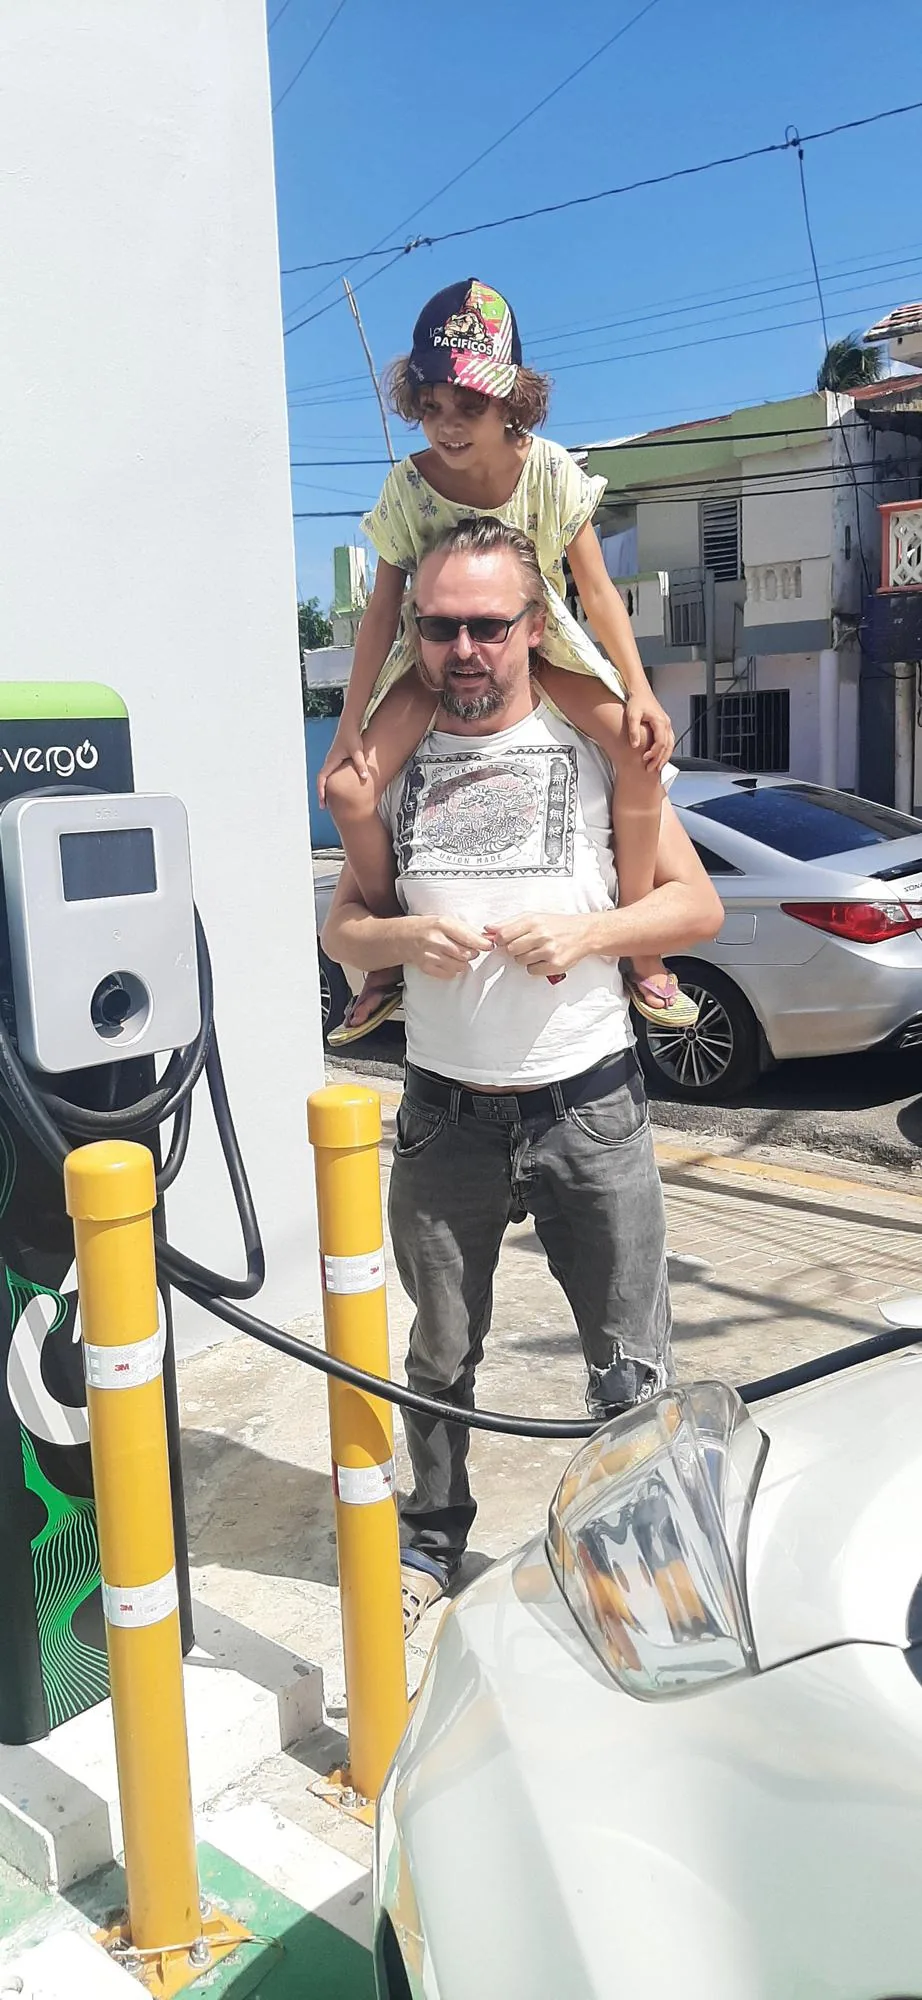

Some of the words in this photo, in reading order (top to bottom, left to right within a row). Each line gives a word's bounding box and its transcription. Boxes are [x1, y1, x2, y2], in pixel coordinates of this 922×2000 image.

[433, 336, 493, 355] PACIFICOS
[0, 739, 99, 777] vergo
[440, 853, 470, 864] UNION
[477, 853, 502, 865] MADE
[114, 1363, 130, 1372] 3M
[119, 1604, 133, 1612] 3M
